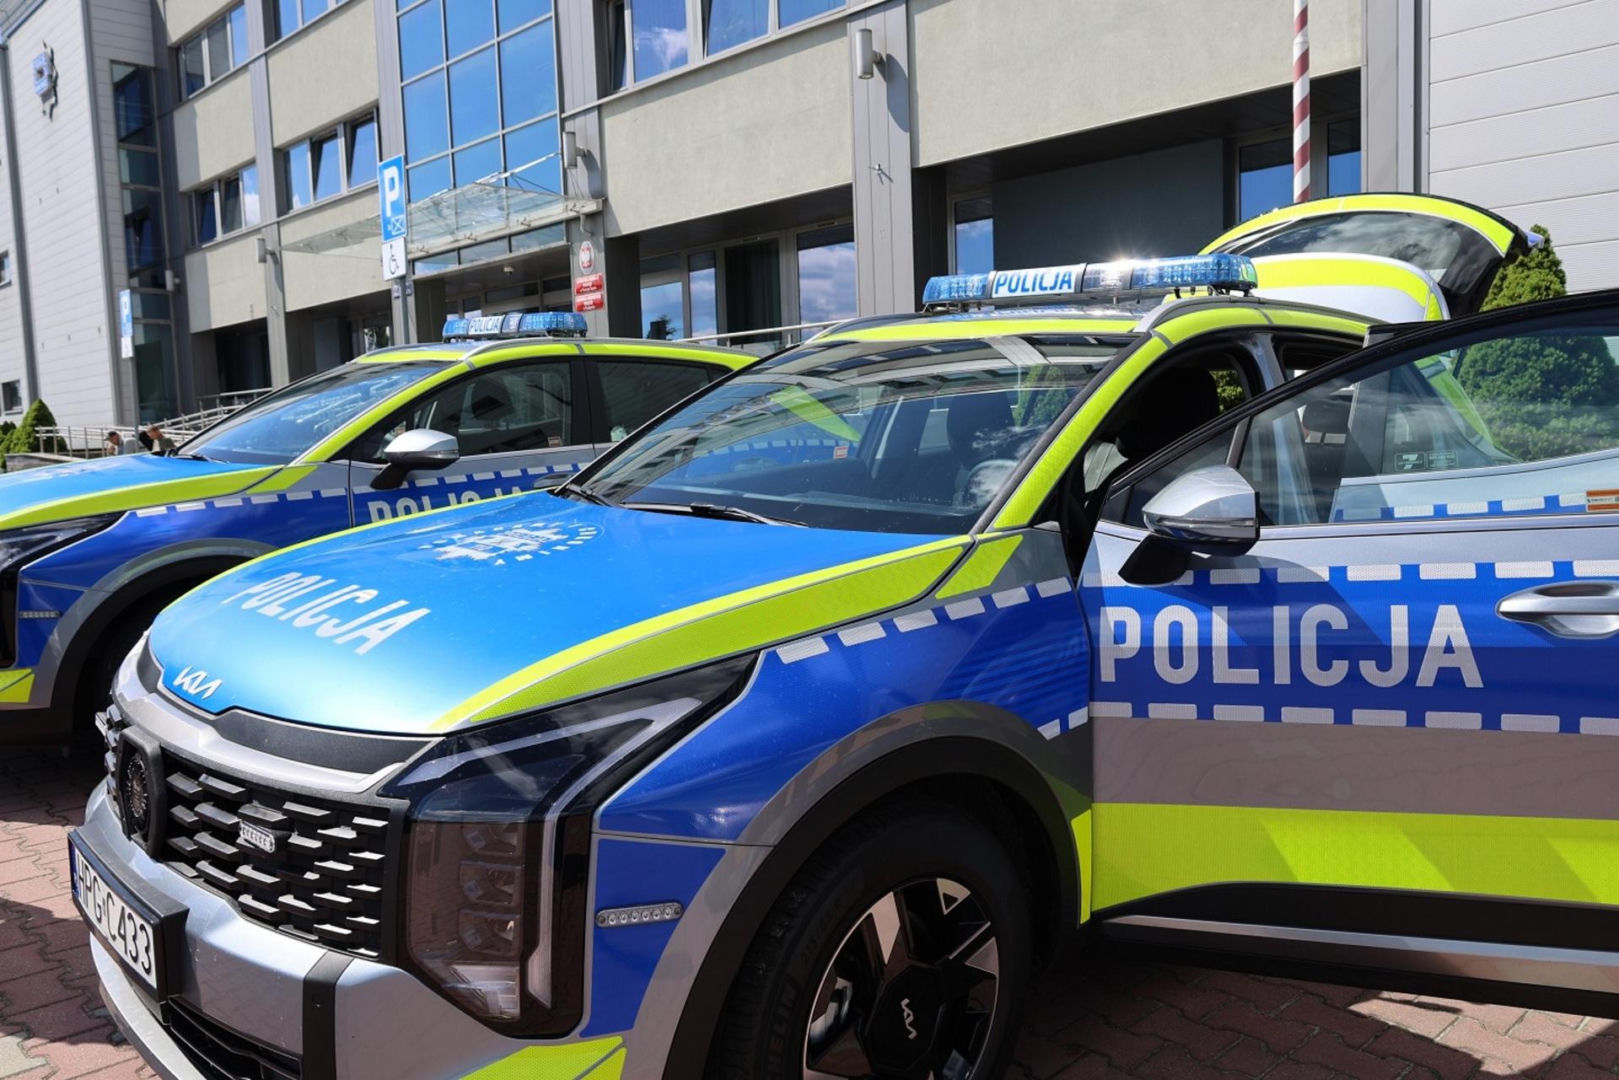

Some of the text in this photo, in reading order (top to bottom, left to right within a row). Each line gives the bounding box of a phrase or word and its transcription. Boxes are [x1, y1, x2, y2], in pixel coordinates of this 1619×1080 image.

[383, 165, 400, 217] P
[994, 270, 1073, 293] POLICJA
[471, 317, 500, 333] POLICJA
[220, 572, 431, 655] POLICJA
[1099, 604, 1484, 688] POLICJA
[173, 665, 223, 699] KIA
[76, 853, 152, 975] HPG C433
